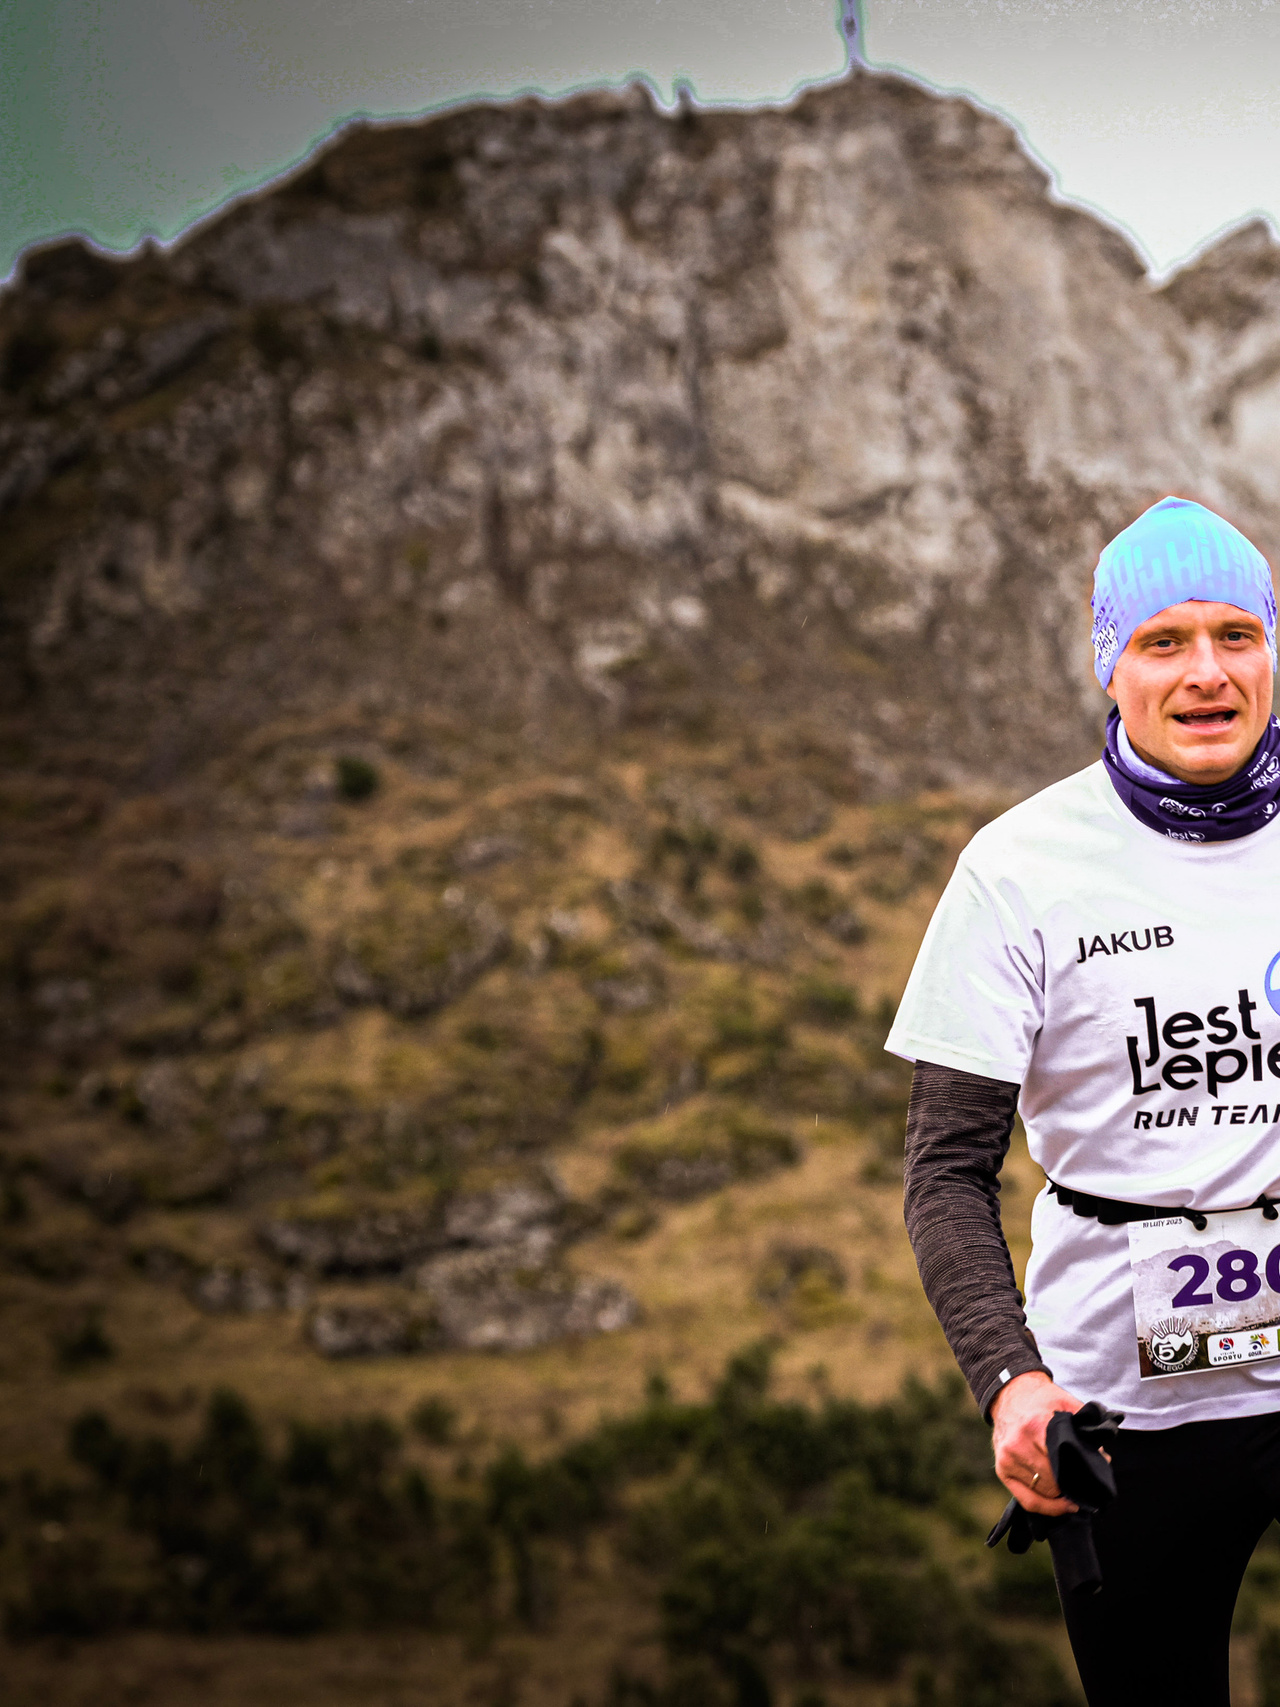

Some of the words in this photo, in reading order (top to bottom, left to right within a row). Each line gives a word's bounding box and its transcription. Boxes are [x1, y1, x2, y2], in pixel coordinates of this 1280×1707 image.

[1077, 925, 1174, 963] JAKUB
[1133, 989, 1261, 1067] Jest
[1134, 1106, 1199, 1129] RUN
[1151, 1315, 1192, 1338] CROSS
[1158, 1344, 1175, 1361] 5
[1213, 1353, 1242, 1362] SPORTU
